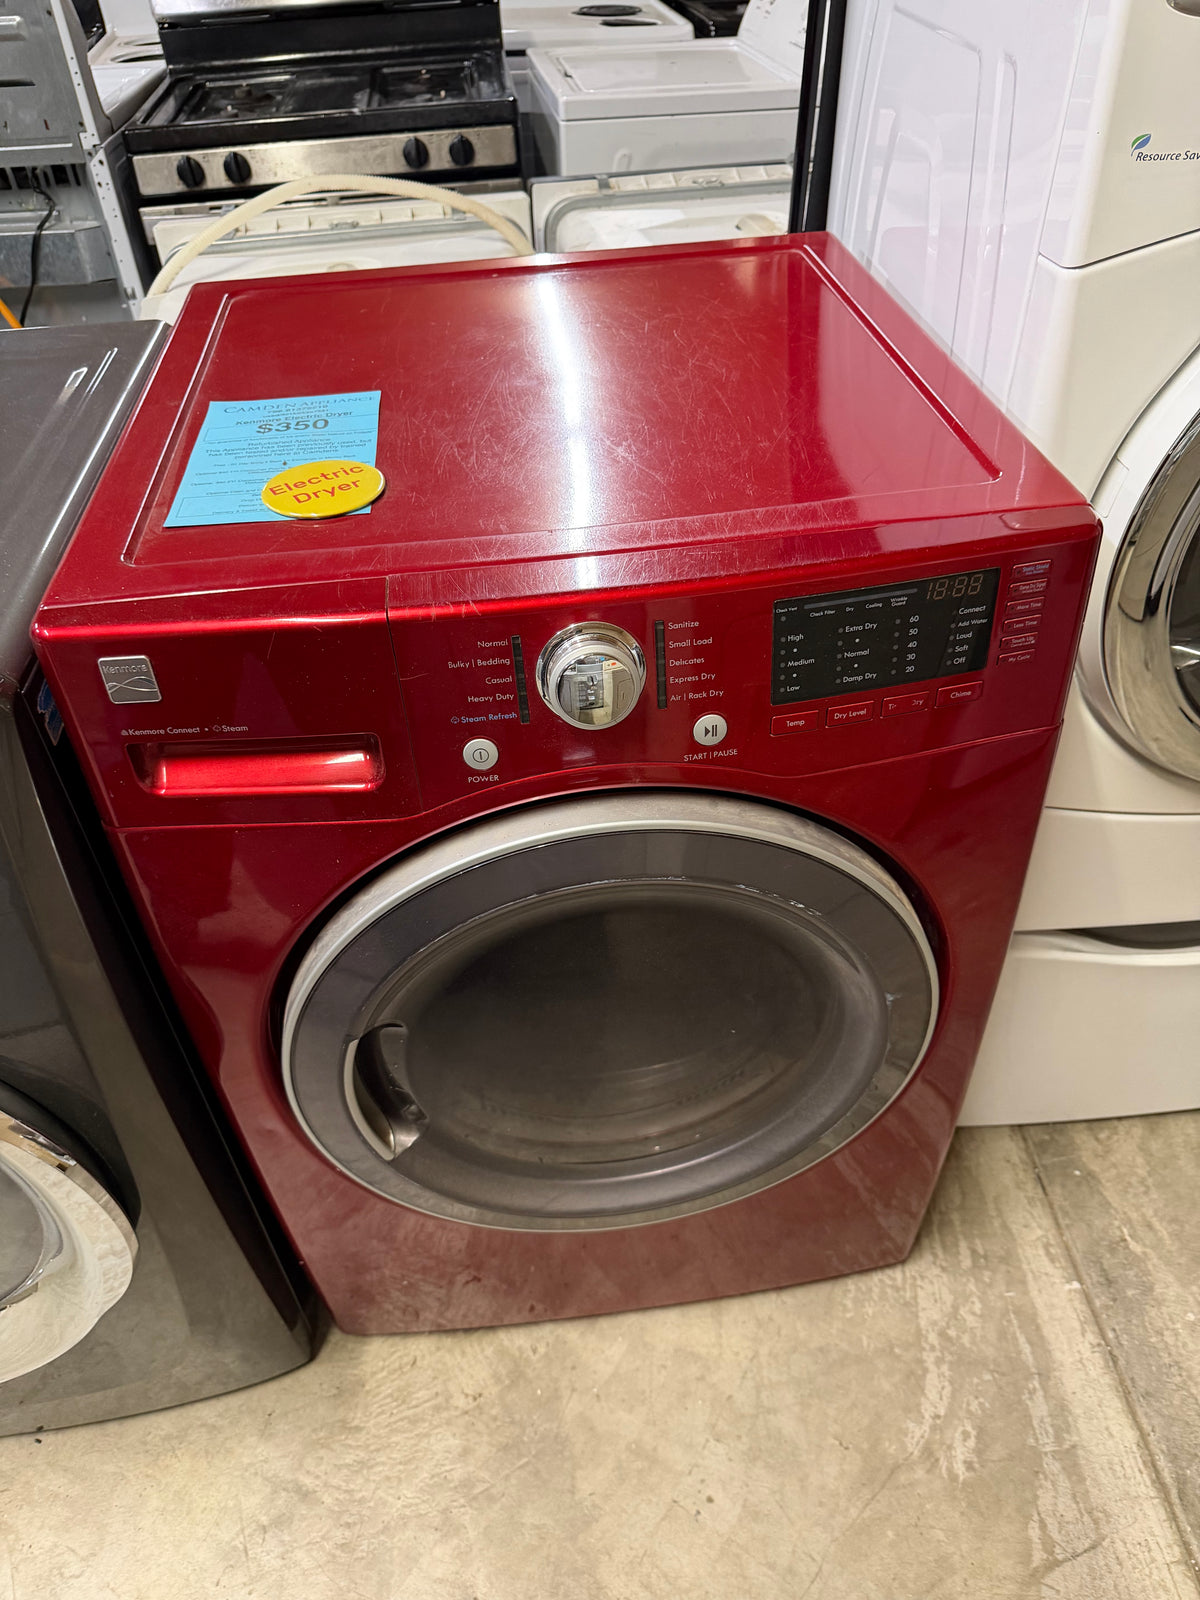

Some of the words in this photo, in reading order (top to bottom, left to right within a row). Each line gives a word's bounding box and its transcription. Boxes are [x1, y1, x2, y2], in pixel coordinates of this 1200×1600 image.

[1135, 151, 1182, 161] Resource
[223, 402, 297, 414] CAMDEN
[300, 396, 375, 406] APPLIANCE
[235, 417, 281, 426] Kenmore
[284, 413, 323, 421] Electric
[325, 411, 352, 419] Dryer
[256, 418, 329, 434] $350
[269, 466, 364, 496] Electric
[293, 480, 360, 504] Dryer
[958, 605, 986, 615] Connect
[909, 615, 920, 623] 60
[668, 621, 699, 630] Sanitize
[845, 625, 863, 633] Extra
[865, 622, 878, 630] Dry
[908, 628, 918, 636] 50
[956, 631, 973, 640] Loud
[787, 633, 804, 642] High
[477, 638, 508, 648] Normal
[668, 638, 691, 649] Small
[693, 637, 713, 645] Load
[955, 644, 969, 652] Soft
[844, 648, 870, 658] Normal
[906, 653, 916, 661] 30
[448, 661, 470, 669] Bulky
[477, 658, 510, 667] Bedding
[669, 657, 705, 667] Delicates
[787, 658, 815, 667] Medium
[953, 656, 966, 665] Off
[103, 663, 148, 674] Kenmore
[485, 675, 513, 685] Casual
[669, 675, 699, 685] Express
[701, 672, 716, 681] Dry
[843, 675, 863, 683] Damp
[864, 672, 877, 680] Dry
[468, 695, 494, 703] Heavy
[495, 693, 514, 701] Duty
[670, 694, 681, 702] Air
[688, 691, 707, 700] Rack
[709, 689, 724, 697] Dry
[950, 690, 972, 699] Chime
[461, 715, 487, 724] Steam
[488, 712, 518, 721] Refresh
[834, 712, 847, 720] Dry
[849, 708, 867, 718] Level
[222, 724, 249, 732] Steam
[786, 719, 805, 728] Temp
[128, 728, 165, 736] Kenmore
[166, 726, 201, 735] Connect
[683, 753, 707, 762] START
[713, 748, 738, 758] PAUSE
[467, 775, 500, 783] POWER
